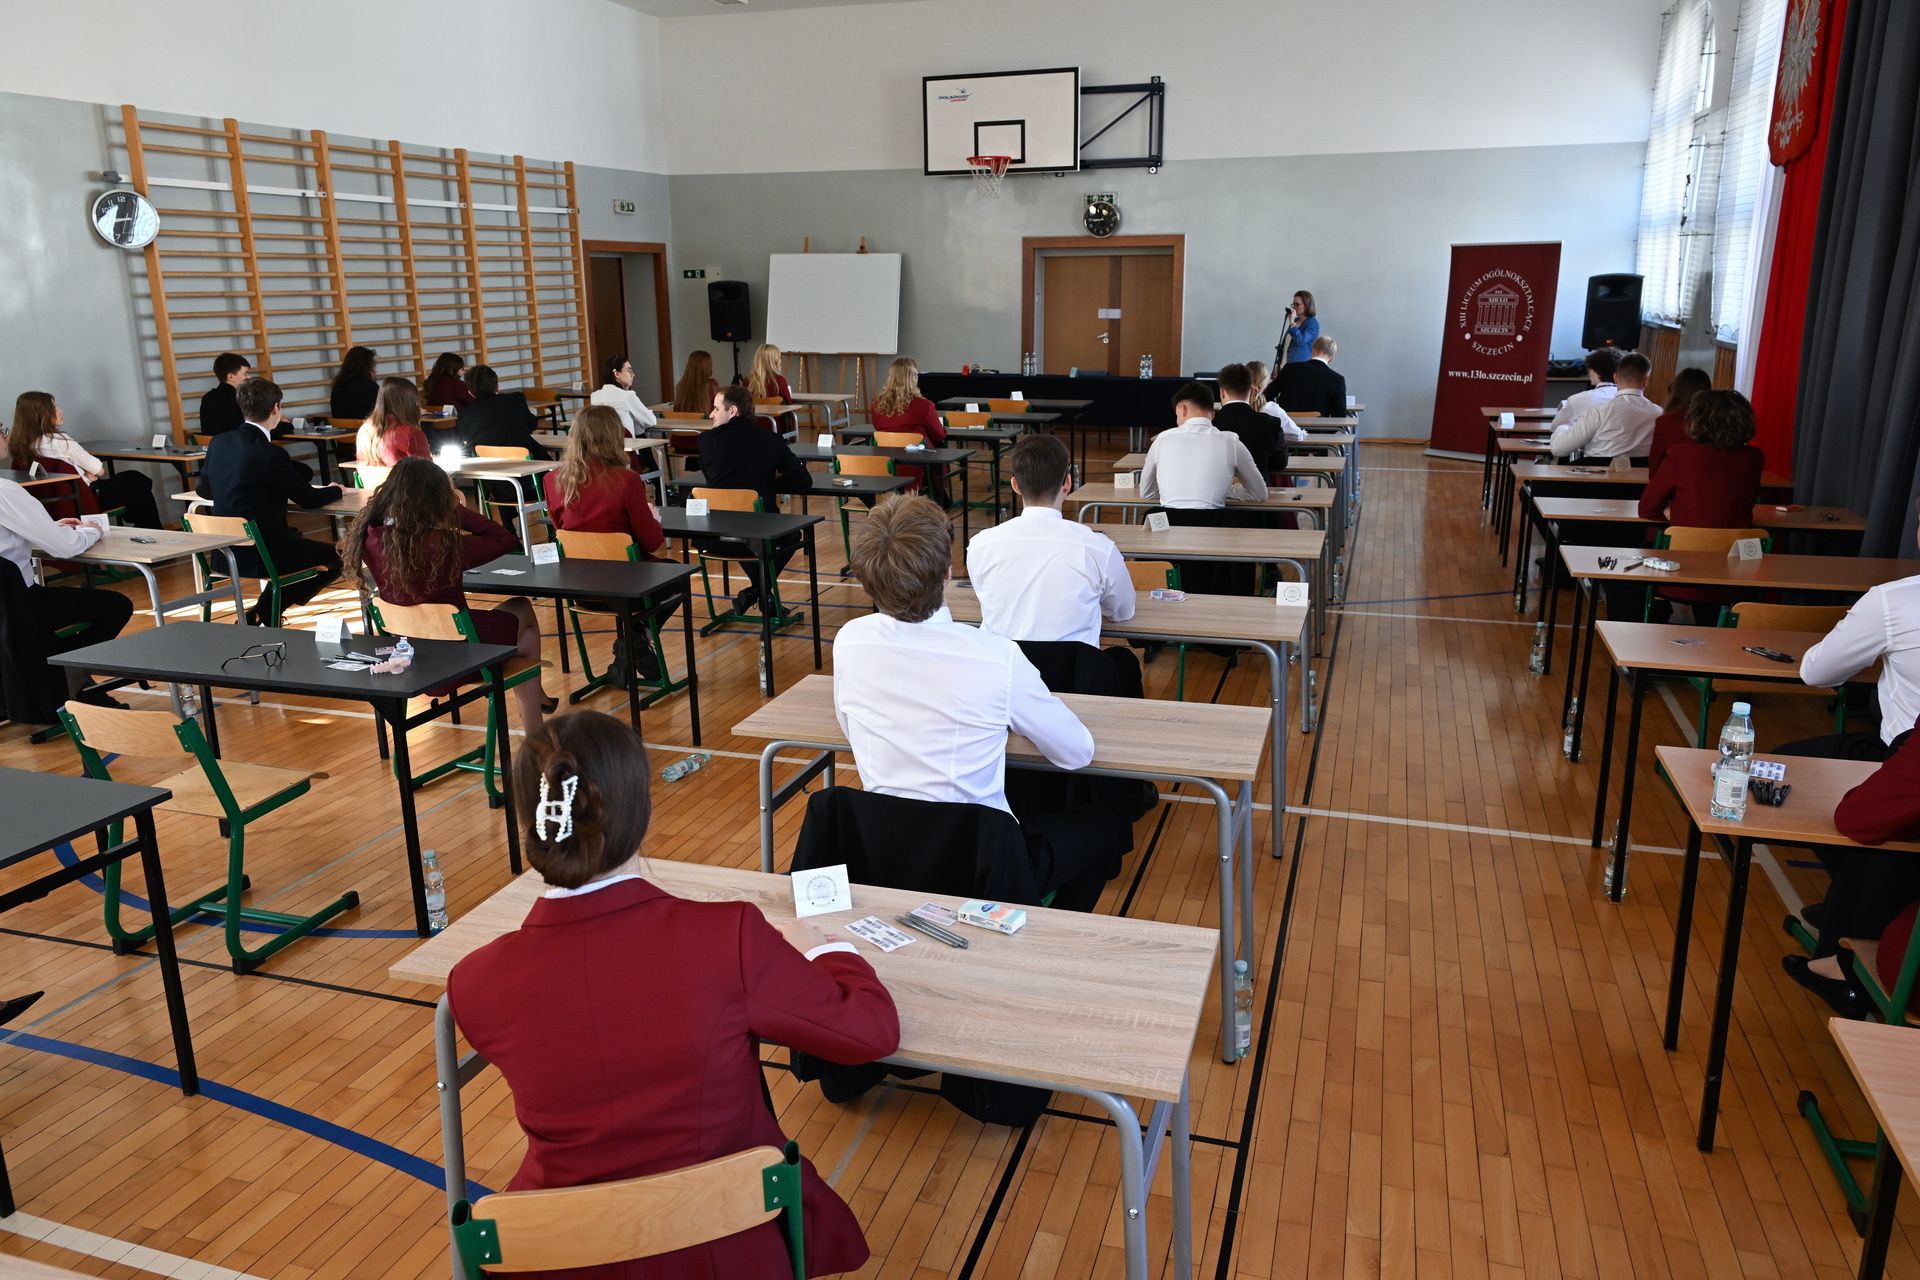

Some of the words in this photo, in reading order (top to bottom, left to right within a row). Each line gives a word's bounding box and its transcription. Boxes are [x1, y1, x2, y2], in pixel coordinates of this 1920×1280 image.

[1460, 278, 1483, 310] LICEUM
[1471, 340, 1515, 356] SZCZECIN
[1448, 369, 1533, 384] www.13lo.szczecin.pl
